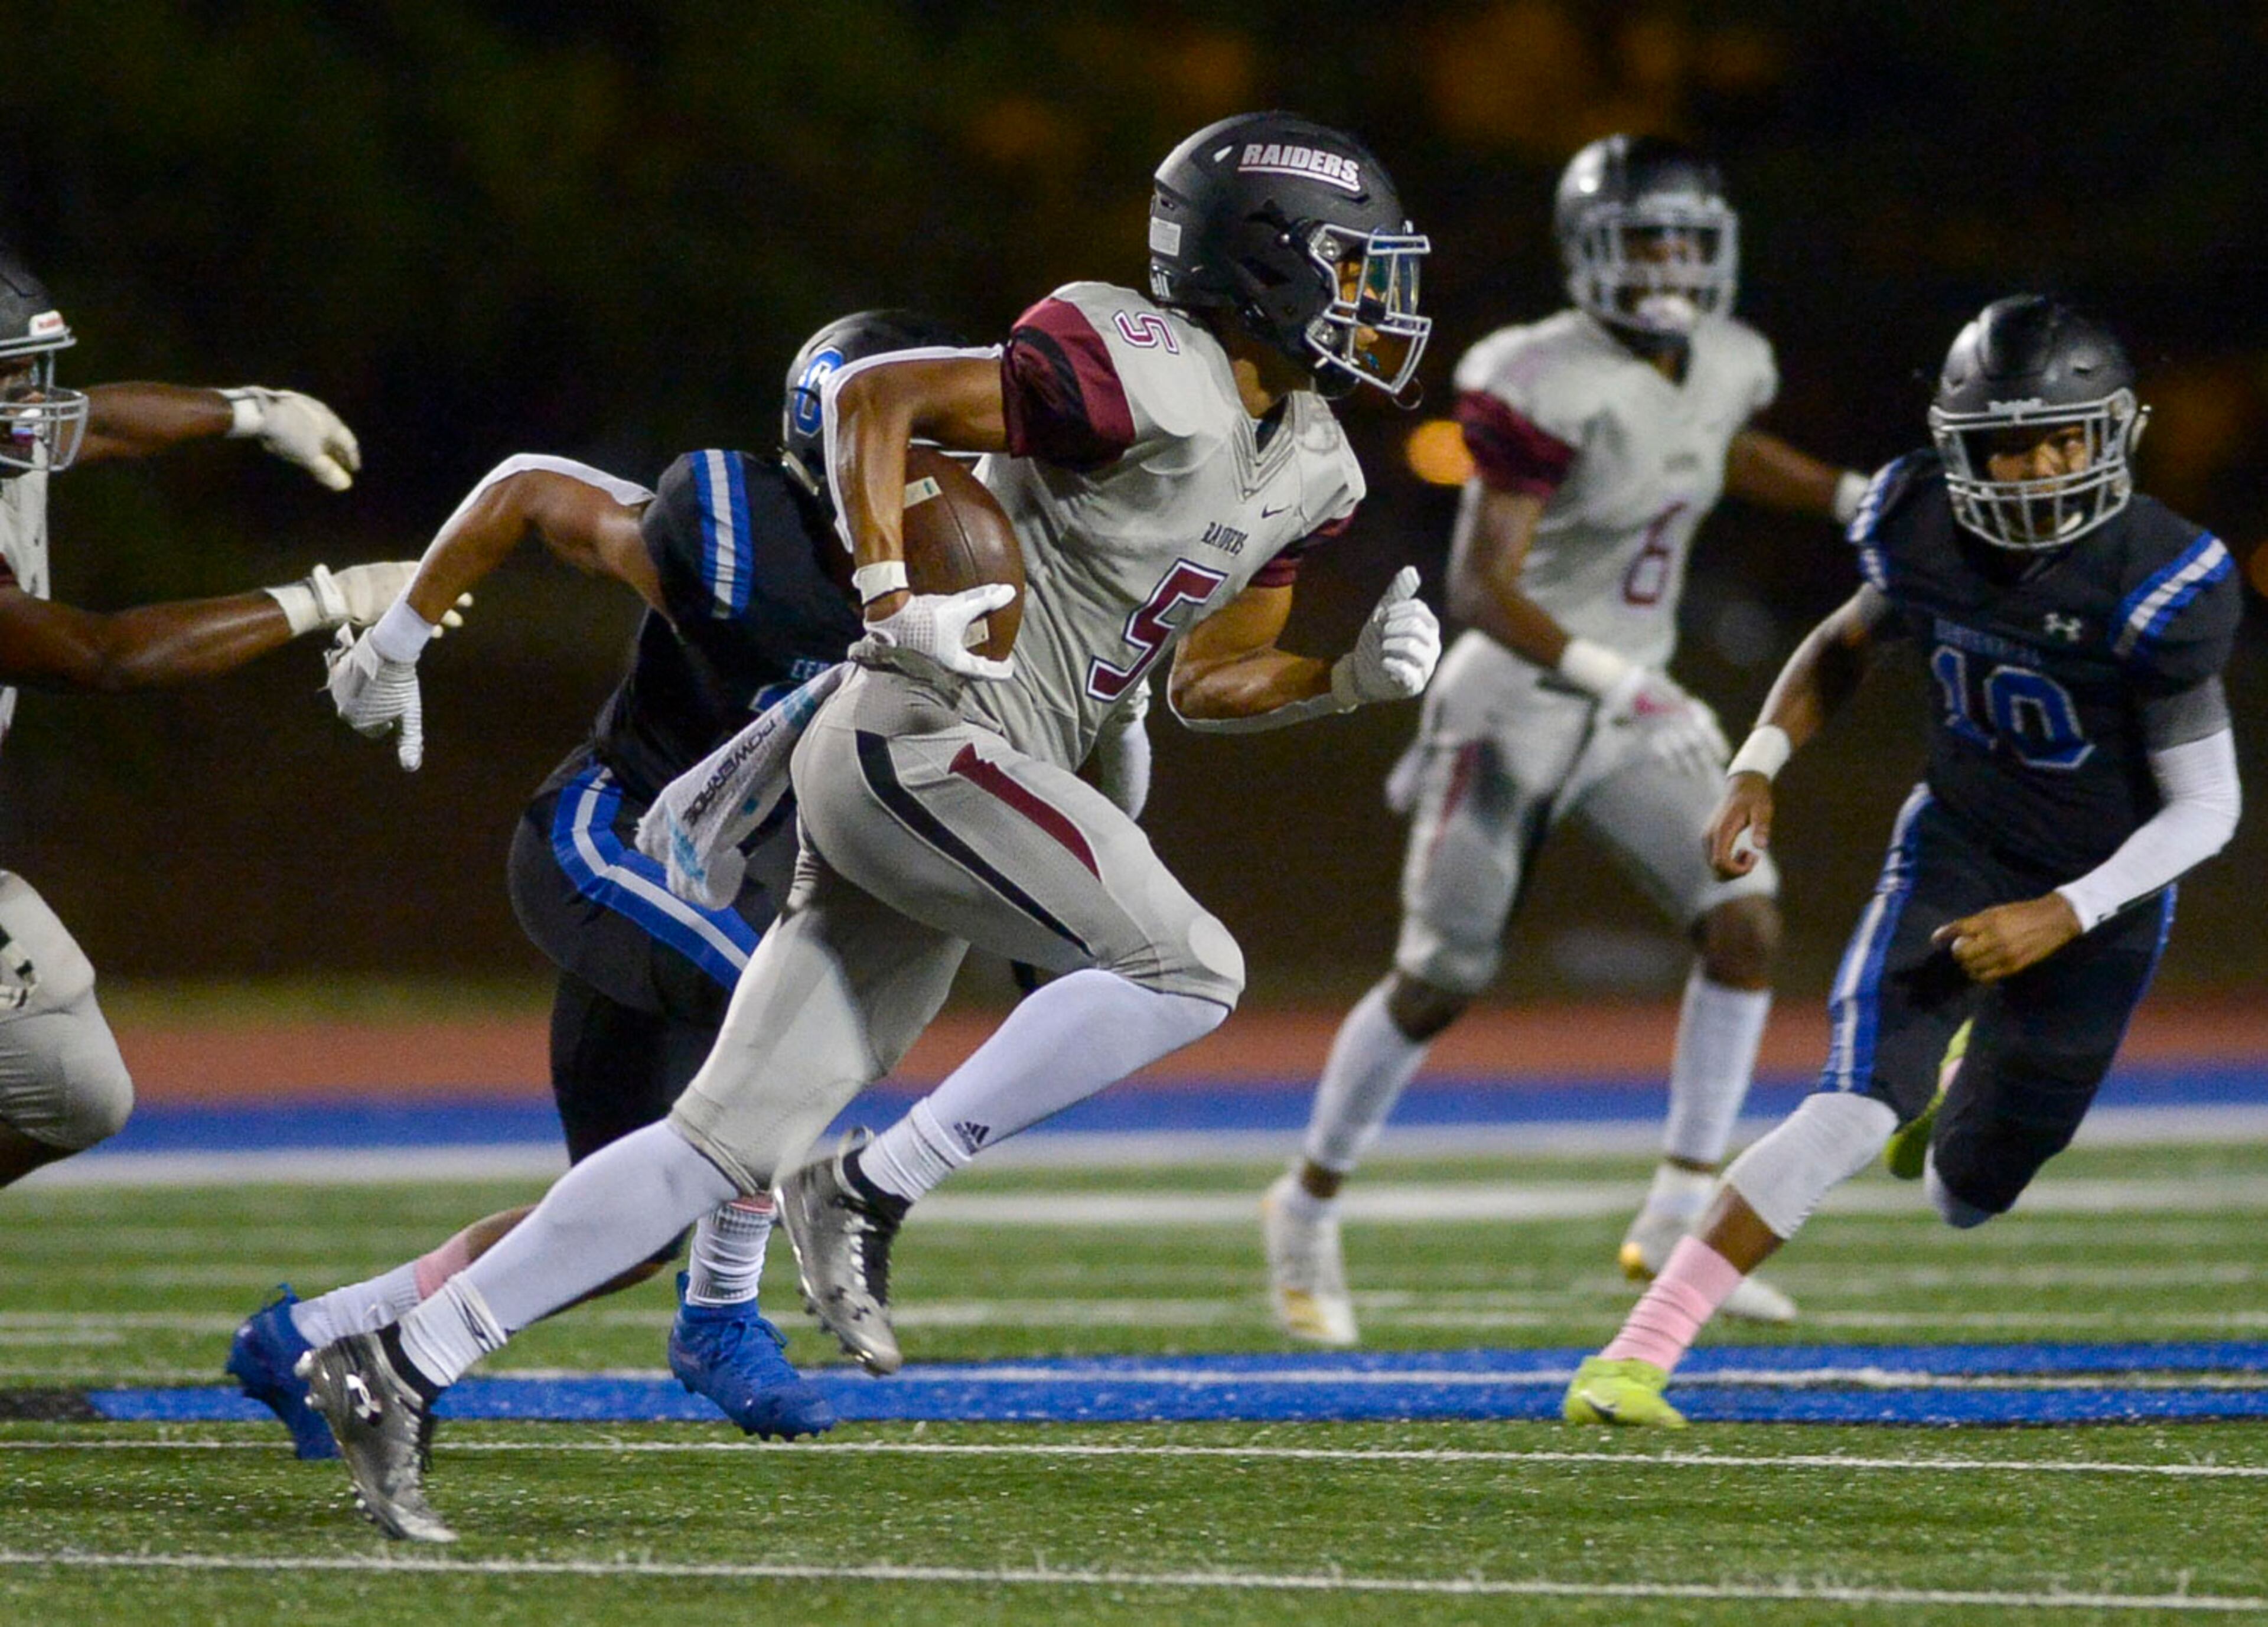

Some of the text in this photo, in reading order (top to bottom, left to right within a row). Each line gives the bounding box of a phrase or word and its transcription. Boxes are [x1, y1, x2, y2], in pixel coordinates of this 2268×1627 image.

[1241, 144, 1360, 182] RAIDERS
[1112, 309, 1180, 355] 5
[1622, 500, 1687, 605] 6
[1086, 557, 1229, 703] 5
[1930, 645, 2096, 768] 10
[682, 719, 777, 827] POWERADE
